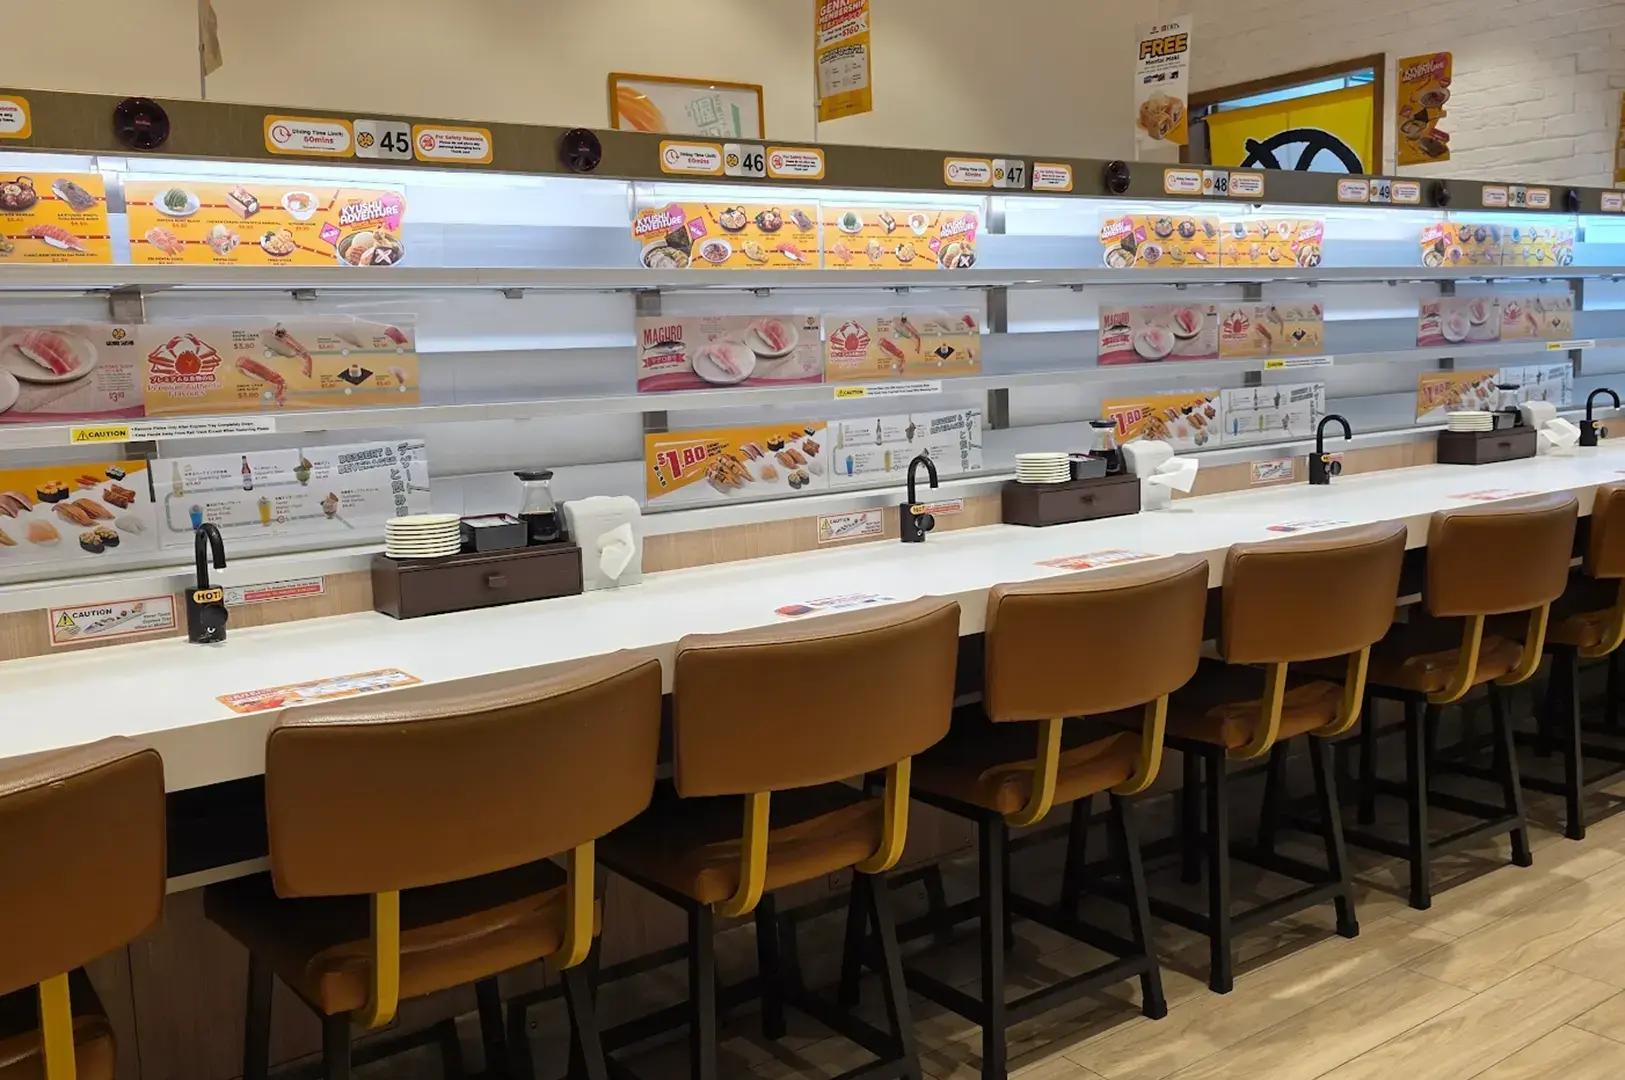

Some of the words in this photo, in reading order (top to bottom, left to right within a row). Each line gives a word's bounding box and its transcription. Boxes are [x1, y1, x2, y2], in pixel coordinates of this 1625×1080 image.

[1140, 33, 1188, 60] FREE
[304, 136, 334, 144] 60mins
[380, 131, 409, 153] 45
[743, 154, 764, 172] 46
[1006, 168, 1023, 182] 47
[1214, 177, 1228, 192] 48
[1379, 186, 1390, 198] 49
[340, 205, 399, 224] ADVENTURE
[342, 200, 383, 215] KYUSHU
[636, 216, 682, 234] ADVENTURE
[638, 211, 670, 226] KYUSHU
[644, 325, 682, 345] MAGURO
[338, 448, 383, 464] DESSERT
[656, 444, 707, 480] $1.80
[338, 456, 397, 474] BEVERAGES
[72, 608, 112, 618] CAUTION
